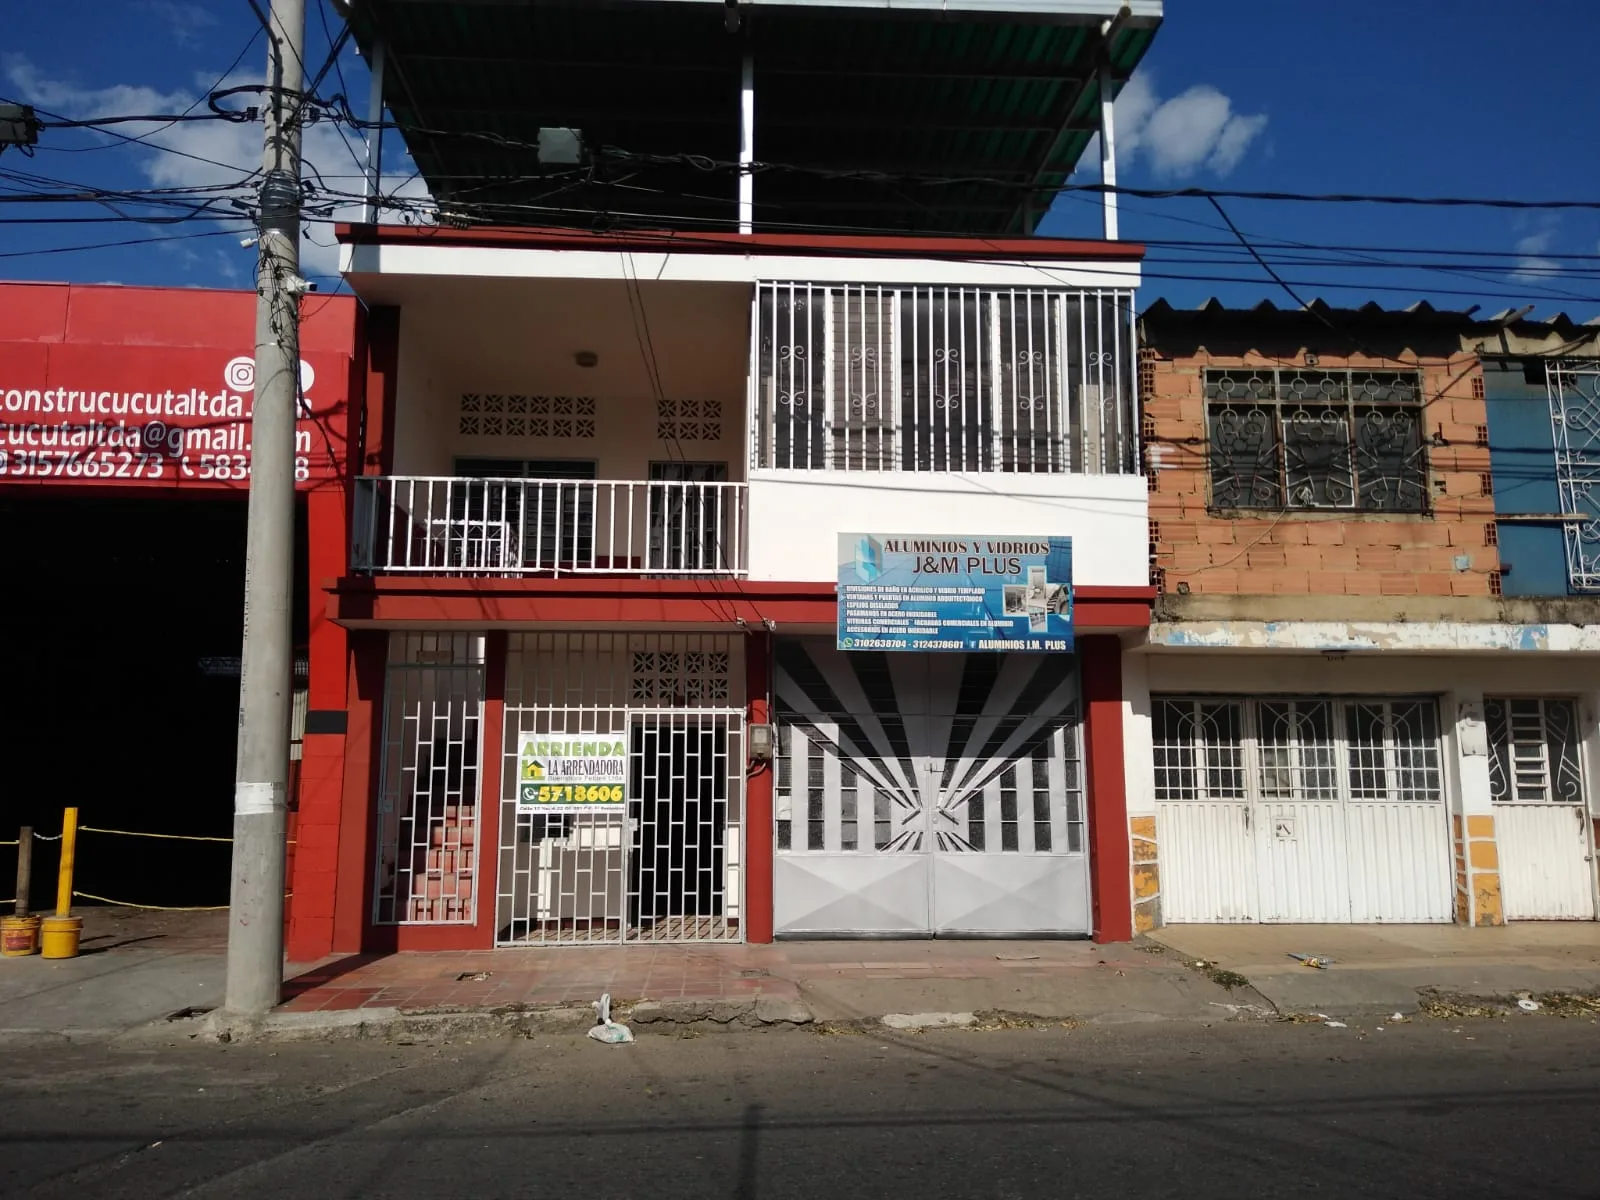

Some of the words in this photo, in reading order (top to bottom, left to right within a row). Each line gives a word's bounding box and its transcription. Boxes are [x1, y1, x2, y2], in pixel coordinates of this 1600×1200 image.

[11, 449, 164, 478] 3157665273
[884, 540, 967, 554] ALUMINIOS
[973, 541, 982, 554] Y
[987, 542, 1050, 555] VIDRIOS
[913, 556, 958, 574] J&M
[967, 557, 1021, 575] PLUS
[979, 639, 1025, 650] ALUMINIOS
[1045, 641, 1066, 650] PLUS
[522, 741, 626, 757] ARRIENDA
[547, 759, 558, 776] LA
[562, 759, 624, 776] ARRENDADORA
[538, 785, 623, 802] 5718606
